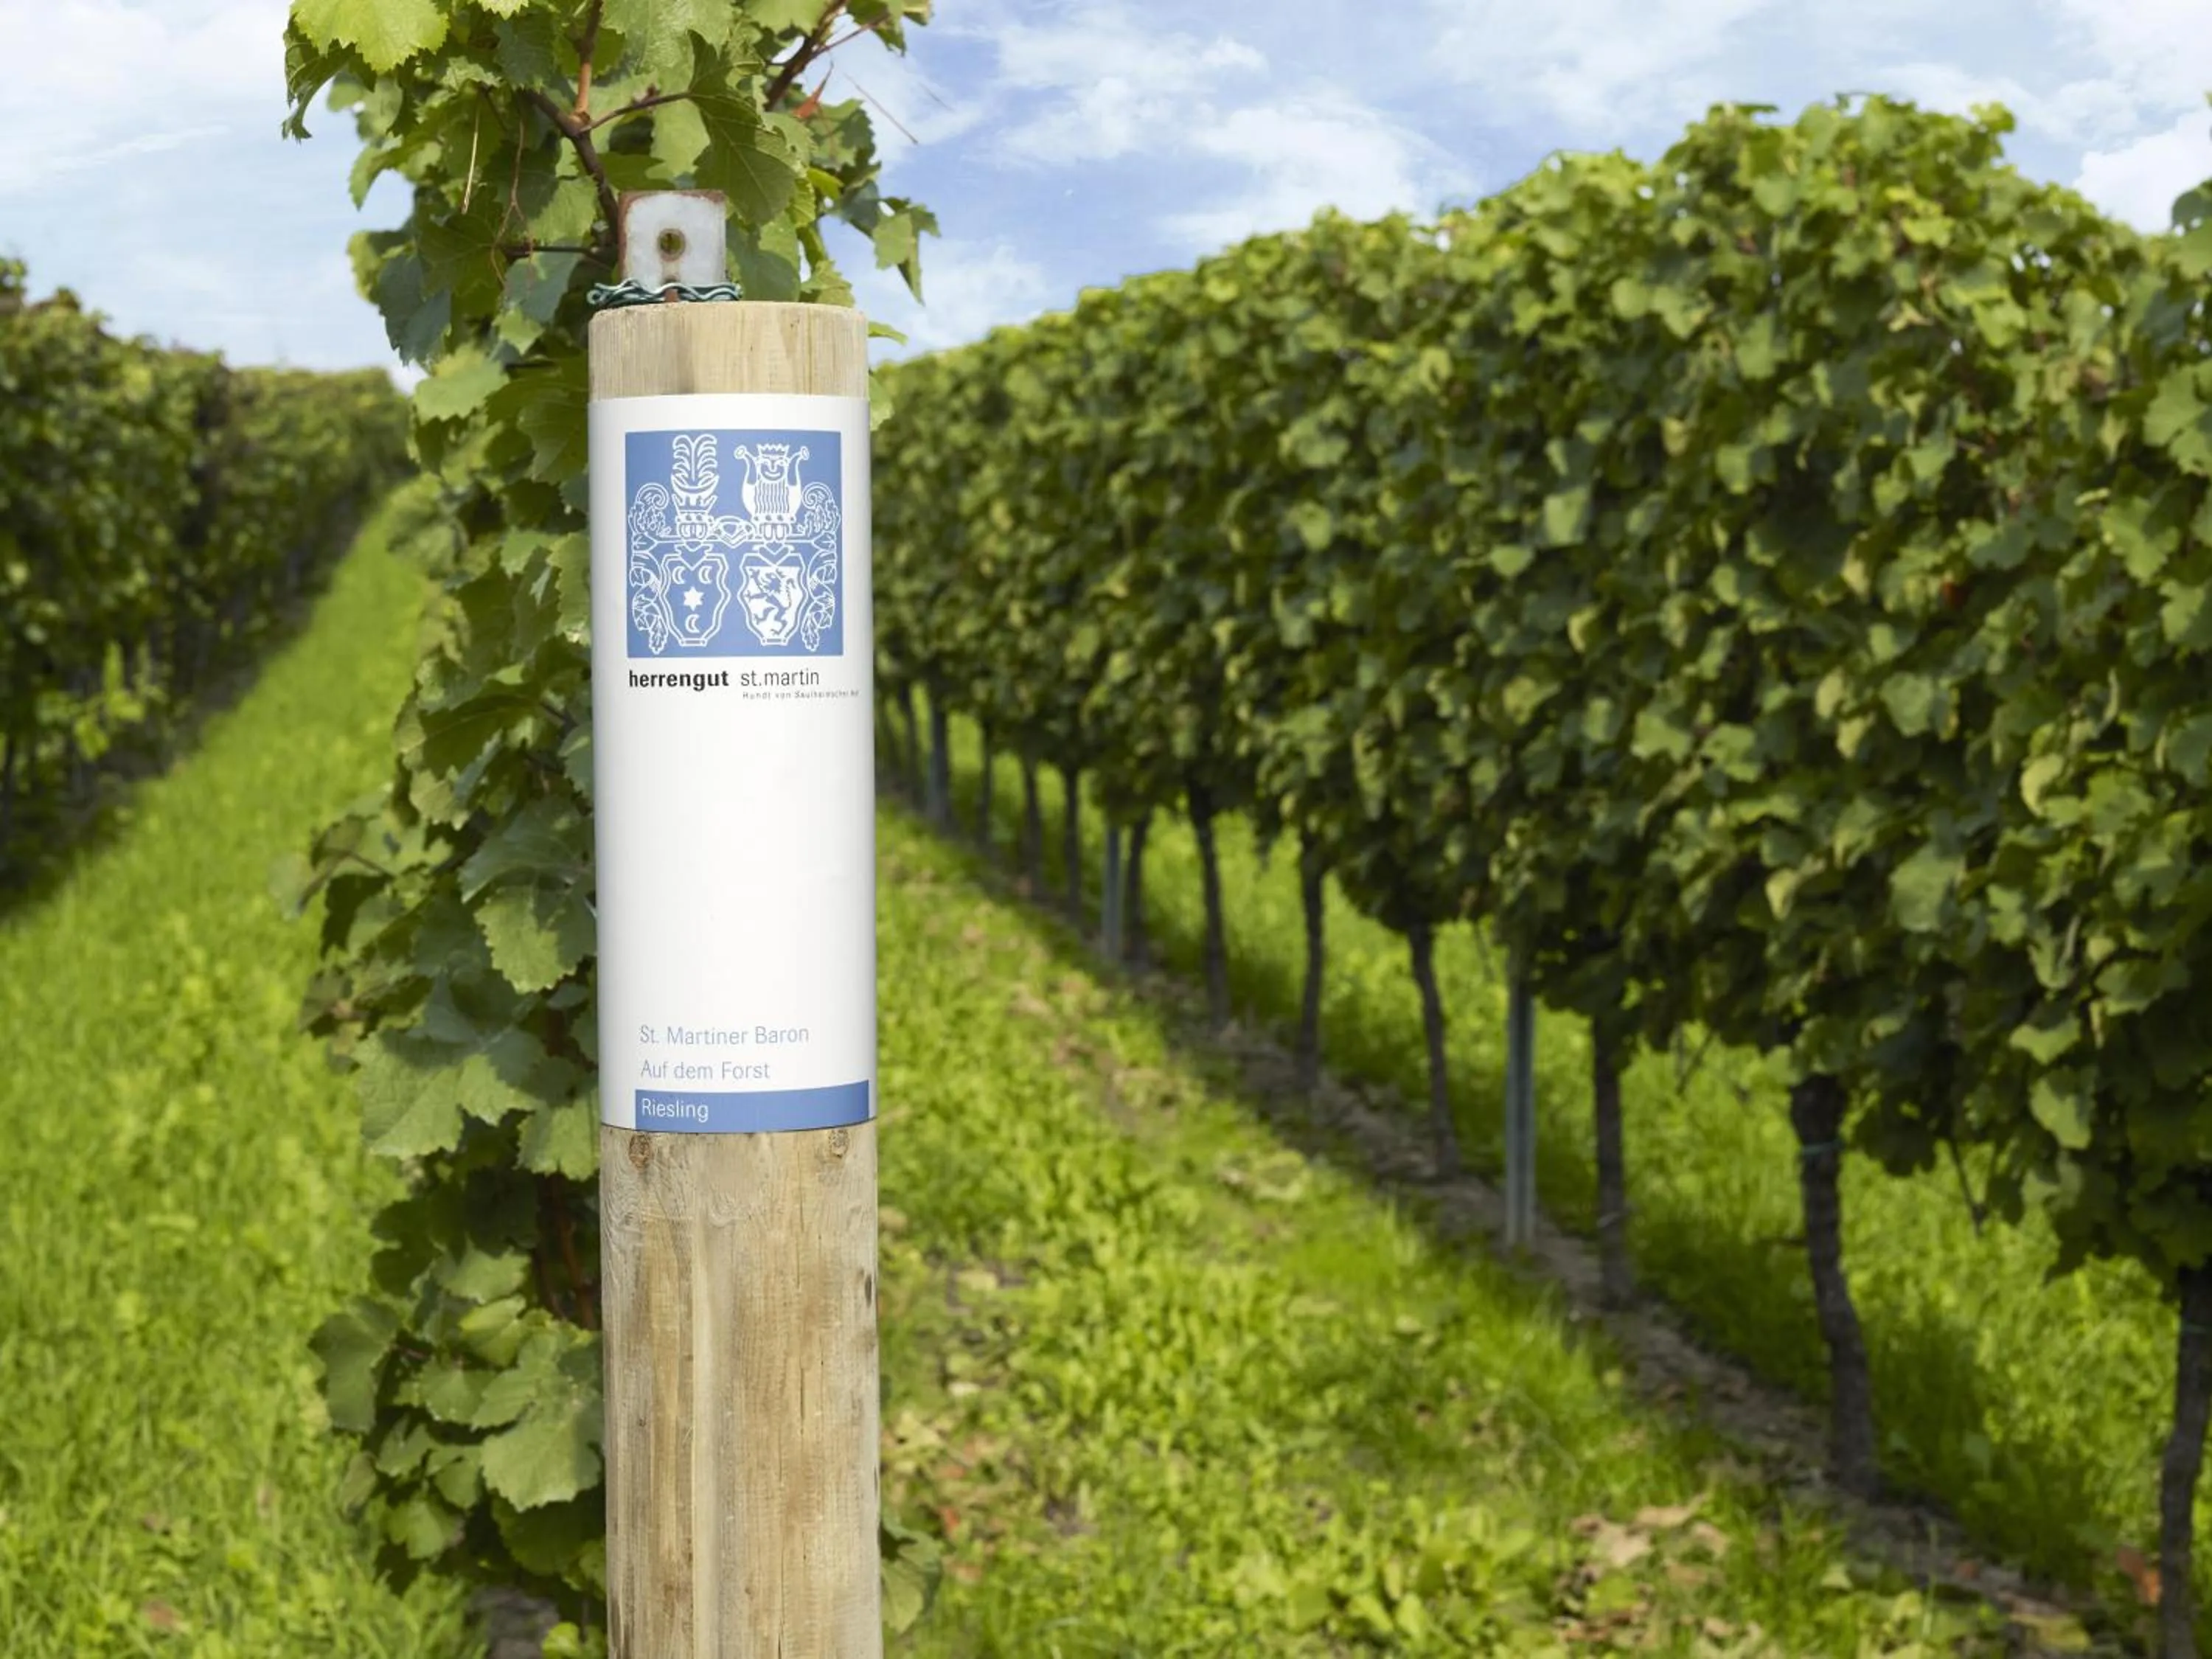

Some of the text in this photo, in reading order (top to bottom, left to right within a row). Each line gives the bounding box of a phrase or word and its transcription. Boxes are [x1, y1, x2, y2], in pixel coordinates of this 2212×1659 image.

[629, 667, 820, 692] herrengut st.martin
[639, 1025, 809, 1045] St. Martiner Baron
[640, 1060, 770, 1079] Auf dem Forst
[641, 1098, 709, 1123] Riesling
